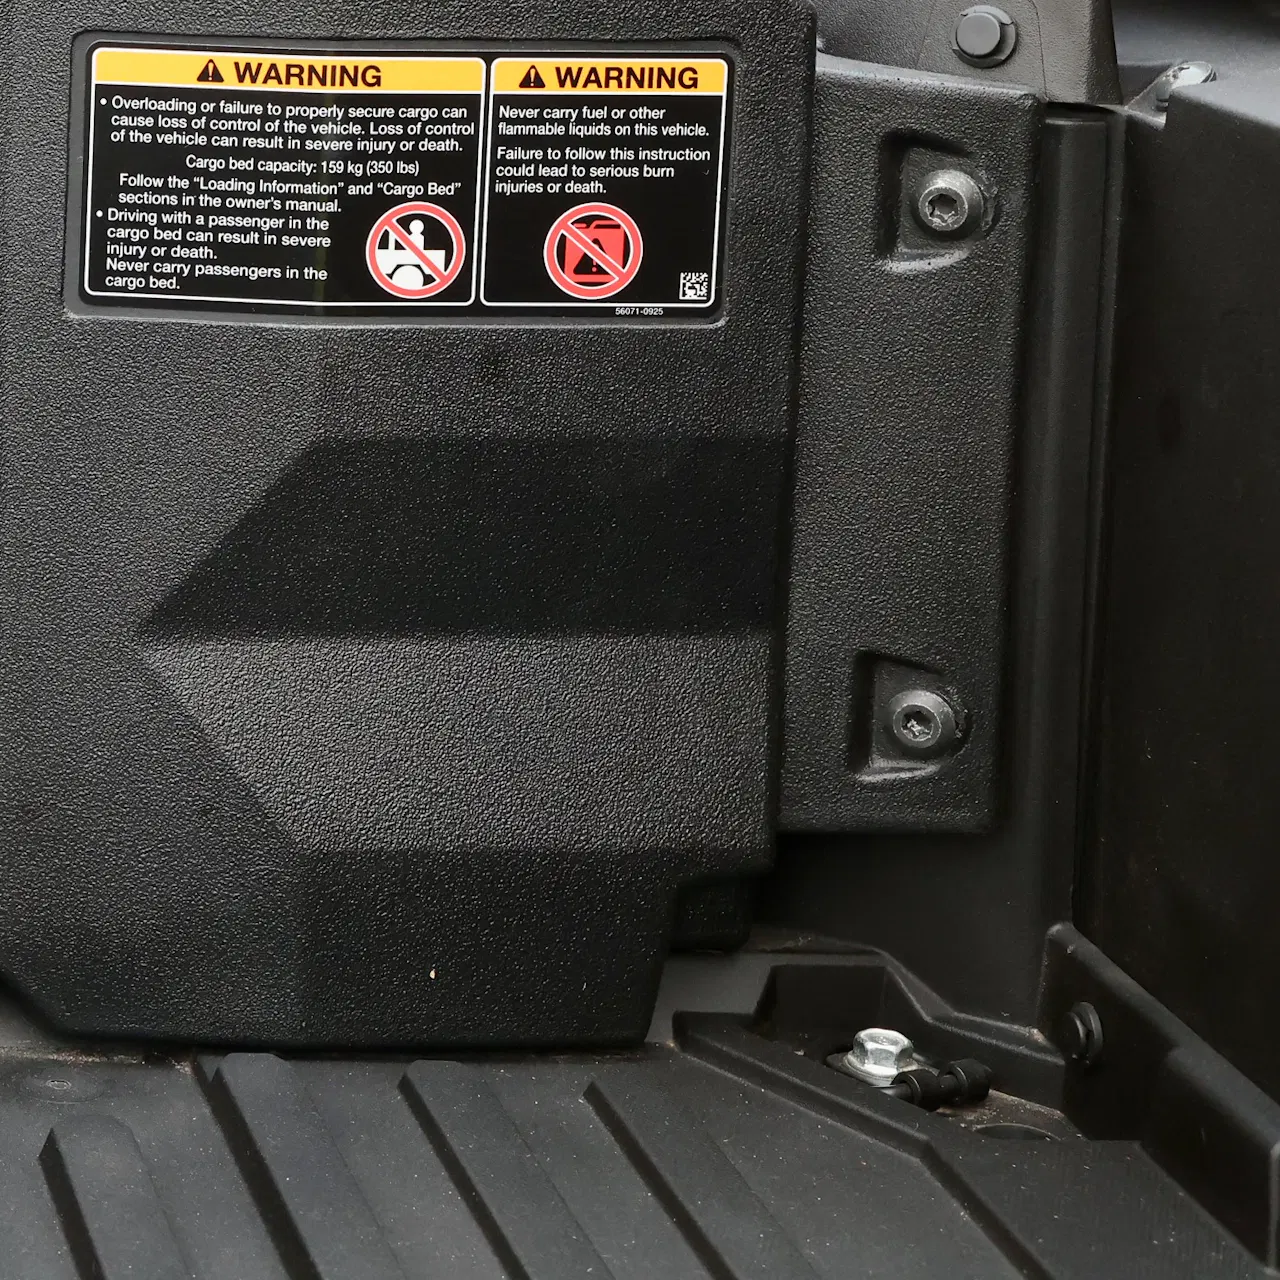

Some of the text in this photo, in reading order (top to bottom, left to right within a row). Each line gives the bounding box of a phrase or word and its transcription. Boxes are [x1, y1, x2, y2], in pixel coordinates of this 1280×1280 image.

[234, 61, 382, 88] WARNING
[555, 66, 699, 90] WARNING
[112, 95, 467, 121] Overloading or failure to properly secure cargo can
[499, 105, 666, 122] Never carry fuel or other
[111, 114, 474, 135] cause loss of control of the vehicle. Loss of control
[498, 122, 709, 138] flammable liquids on this vehicle.
[111, 129, 463, 154] of the vehicle can result in severe injury or death.
[497, 146, 710, 161] Failure to follow this instruction
[186, 154, 419, 177] Cargo bed capacity: 159 kg (350 lbs)
[496, 163, 674, 177] could lead to serious burn
[120, 173, 164, 187] Follow
[167, 175, 190, 189] the
[347, 182, 373, 195] and
[495, 180, 606, 196] injuries or death.
[118, 191, 178, 205] sections
[182, 193, 194, 206] in
[198, 194, 222, 207] the
[286, 199, 341, 212] manual.
[108, 207, 329, 231] Driving with a passenger in the
[107, 227, 331, 247] cargo bed can result in severe
[107, 242, 217, 259] injury or death.
[106, 257, 328, 280] Never carry passengers in the
[105, 275, 180, 290] cargo bed.
[615, 307, 664, 316] 56071-0925
